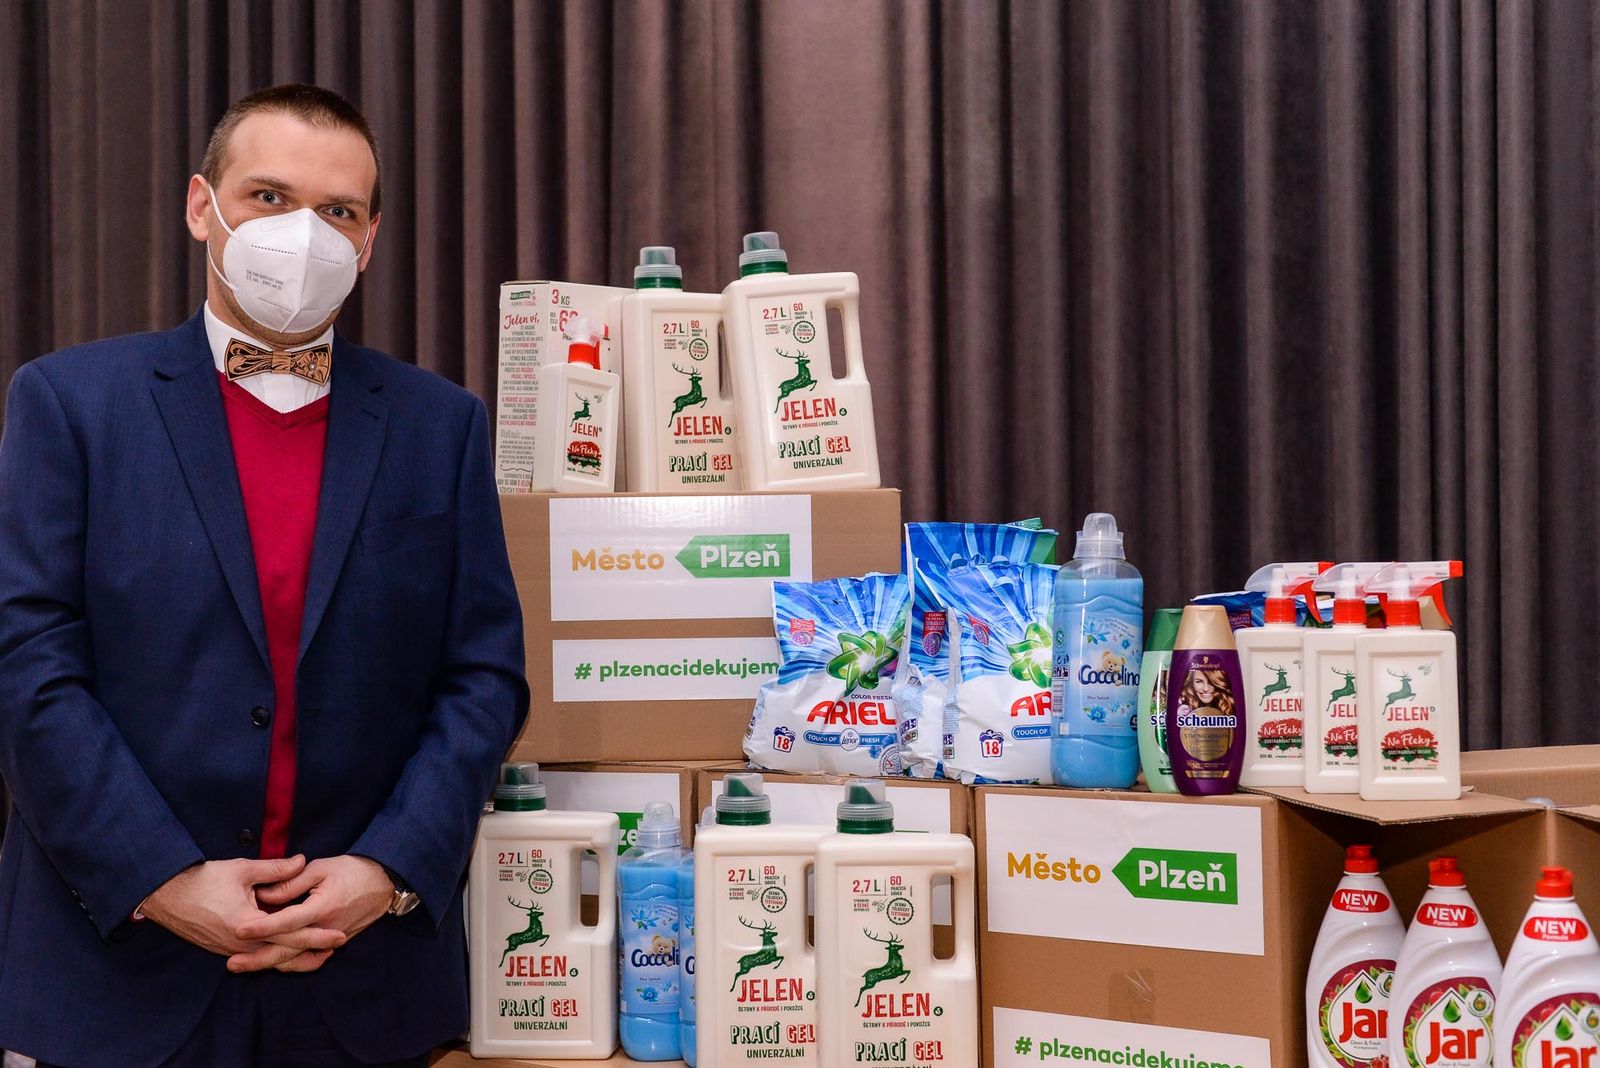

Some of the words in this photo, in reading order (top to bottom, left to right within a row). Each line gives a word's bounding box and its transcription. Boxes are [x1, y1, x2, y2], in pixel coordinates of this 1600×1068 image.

[552, 289, 559, 304] 3
[560, 295, 571, 306] KG
[763, 308, 778, 320] 2,7
[780, 307, 786, 318] L
[793, 303, 803, 312] 60
[504, 314, 528, 330] Jelen
[663, 323, 677, 334] 2,7
[679, 322, 684, 334] L
[690, 320, 700, 328] 60
[781, 398, 837, 422] JELEN
[572, 422, 599, 438] JELEN
[674, 416, 722, 436] JELEN
[778, 434, 820, 458] PRACÍ
[826, 436, 851, 454] GEL
[669, 452, 708, 472] PRACÍ
[712, 454, 733, 470] GEL
[793, 456, 843, 470] UNIVERZÁLNÍ
[682, 474, 726, 484] UNIVERZÁLNÍ
[571, 547, 665, 572] Město
[700, 544, 781, 569] Plzeň
[600, 657, 779, 683] plzenacidekujem
[1078, 664, 1140, 687] Coccolino
[1264, 698, 1302, 712] JELEN
[807, 700, 897, 726] ARIEL
[1387, 706, 1429, 722] JELEN
[1177, 714, 1236, 727] schauma
[808, 734, 827, 742] TOUCH
[1264, 726, 1276, 736] Na
[1330, 732, 1342, 742] Na
[778, 736, 790, 750] 18
[1387, 737, 1401, 747] Na
[1401, 734, 1431, 746] Fleky
[985, 742, 999, 754] 18
[498, 852, 514, 865] 2,7
[517, 852, 524, 864] L
[532, 849, 542, 858] 60
[728, 869, 746, 882] 2,7
[748, 868, 756, 882] L
[764, 865, 776, 875] 60
[1007, 852, 1102, 884] Město
[1138, 859, 1226, 892] Plzeň
[852, 880, 871, 893] 2,7
[874, 879, 881, 892] L
[890, 876, 902, 886] 60
[1340, 892, 1378, 906] NEW
[1426, 906, 1467, 921] NEW
[1433, 919, 1458, 927] Formula
[1534, 920, 1577, 934] NEW
[1542, 933, 1569, 941] Formula
[630, 946, 680, 968] Coccoli
[504, 956, 567, 978] JELEN
[736, 978, 803, 1002] JELEN
[498, 995, 545, 1017] PRACÍ
[550, 998, 578, 1018] GEL
[862, 992, 930, 1018] JELEN
[514, 1020, 568, 1031] UNIVERZÁLNÍ
[1339, 1002, 1388, 1044] Jar
[730, 1020, 780, 1044] PRACÍ
[786, 1024, 816, 1044] GEL
[855, 1037, 907, 1062] PRACÍ
[913, 1040, 944, 1061] GEL
[1426, 1022, 1484, 1065] Jar
[746, 1046, 805, 1058] UNIVERZÁLNÍ
